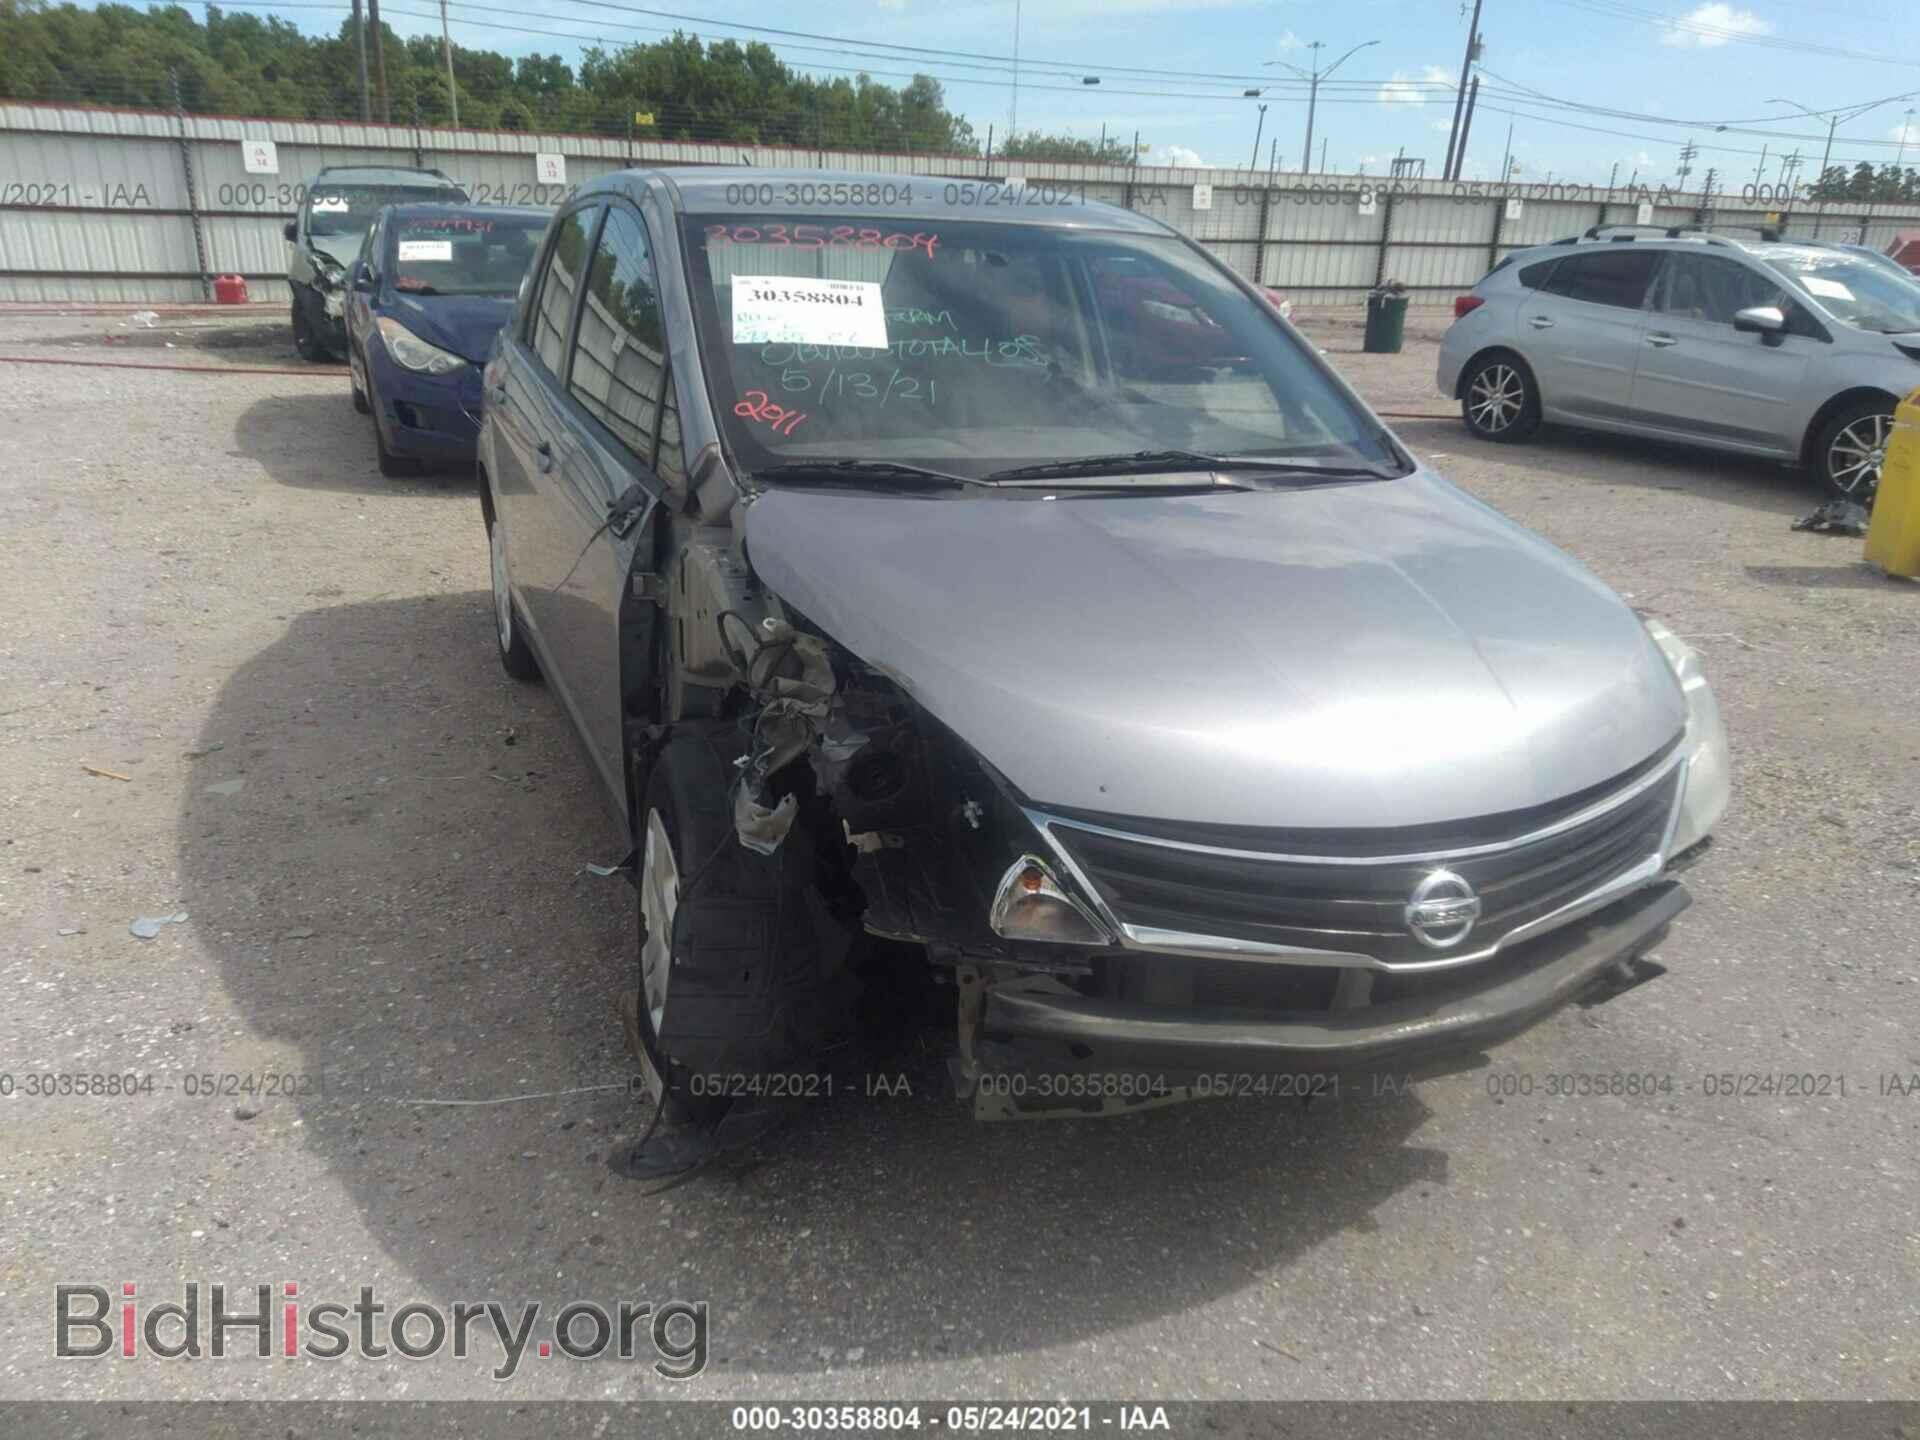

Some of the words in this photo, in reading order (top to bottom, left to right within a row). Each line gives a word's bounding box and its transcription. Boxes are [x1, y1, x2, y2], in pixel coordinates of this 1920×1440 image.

[703, 225, 940, 259] 30358804
[747, 289, 864, 307] 30358804
[781, 367, 936, 408] 5/13/21
[734, 391, 808, 435] 2011
